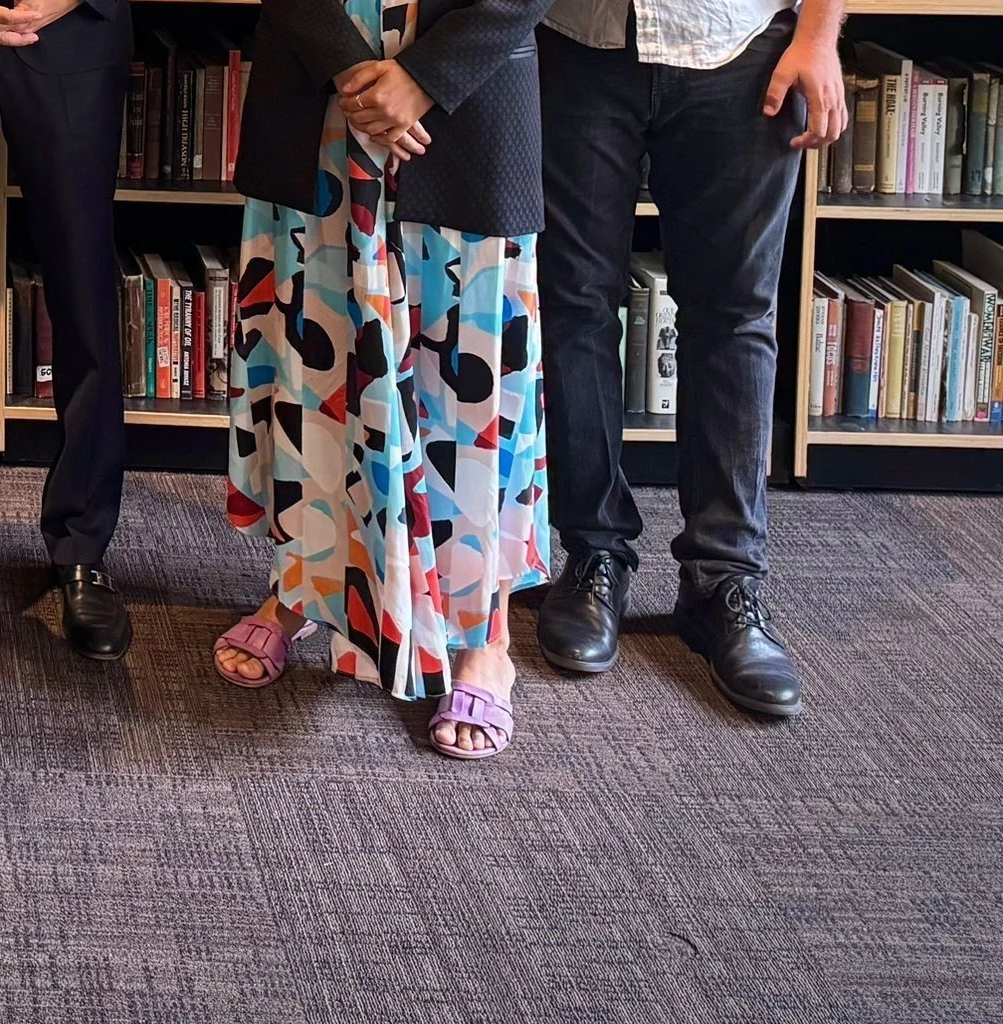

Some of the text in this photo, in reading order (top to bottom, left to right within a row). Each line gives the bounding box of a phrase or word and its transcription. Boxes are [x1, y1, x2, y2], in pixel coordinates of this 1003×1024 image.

[886, 79, 897, 92] THE
[885, 93, 897, 116] HOAX:
[918, 92, 928, 135] Burning Valley
[934, 92, 944, 136] Burning Valley
[184, 290, 192, 347] THE TYRANNY OF OIL
[983, 295, 996, 331] WOMEN
[826, 341, 837, 366] FOCUS
[980, 337, 993, 363] WAR
